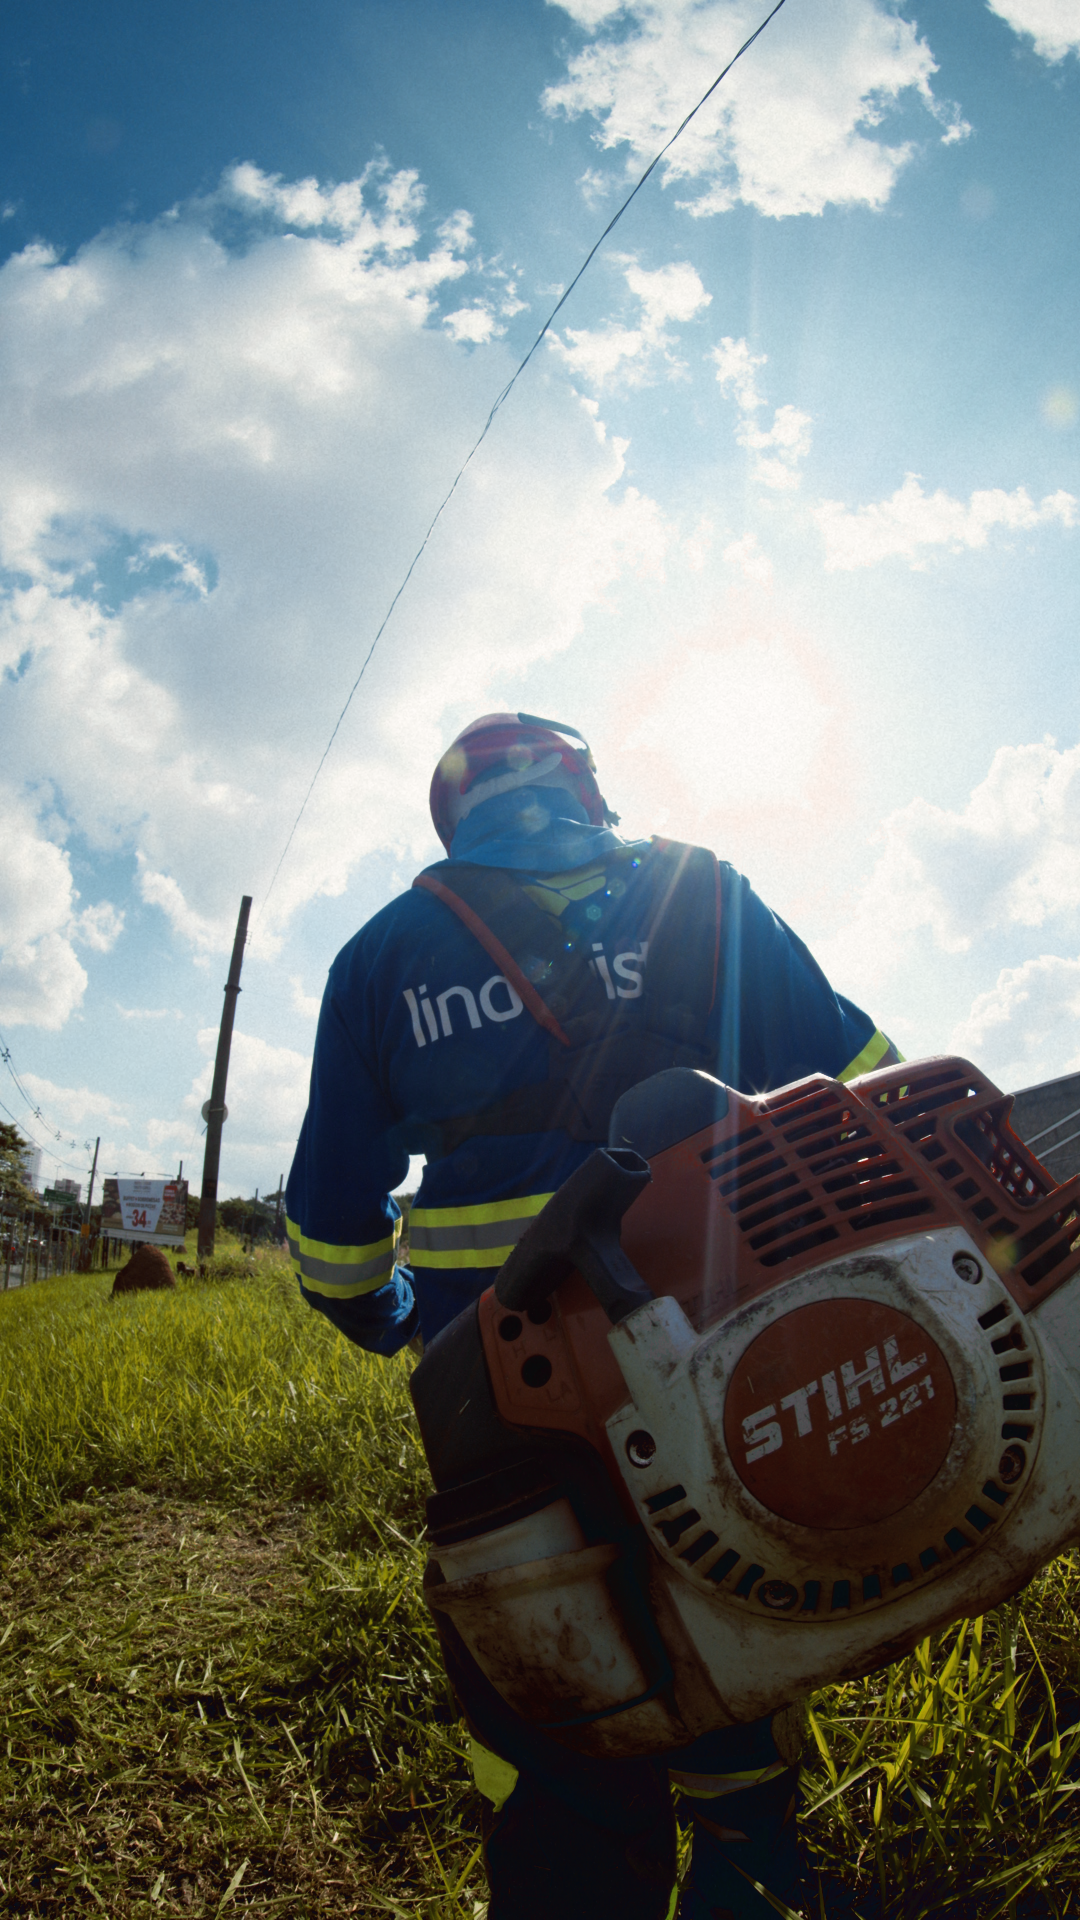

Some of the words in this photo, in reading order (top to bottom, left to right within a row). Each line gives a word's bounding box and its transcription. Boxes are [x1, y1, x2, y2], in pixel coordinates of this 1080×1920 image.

[132, 1209, 147, 1228] 34
[741, 1334, 928, 1464] STIHL
[827, 1416, 871, 1456] FS
[879, 1374, 936, 1428] 221
